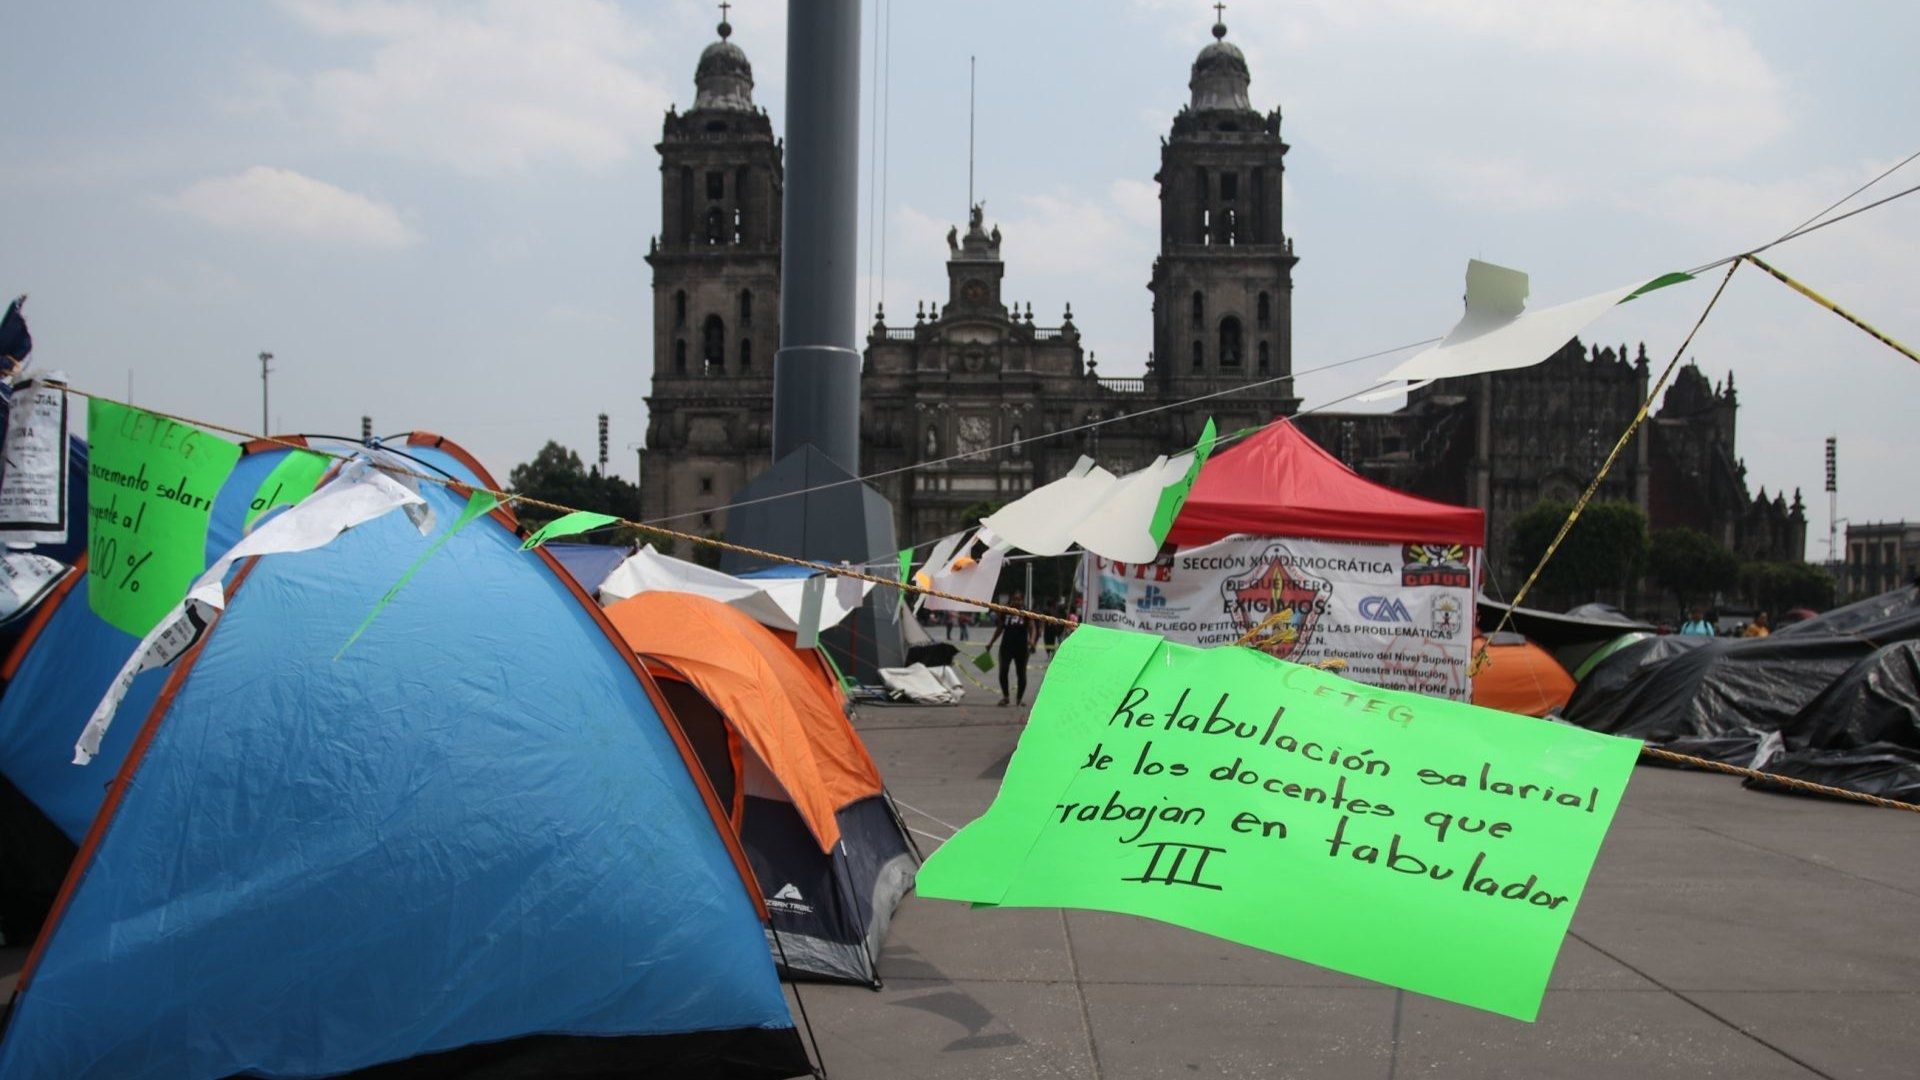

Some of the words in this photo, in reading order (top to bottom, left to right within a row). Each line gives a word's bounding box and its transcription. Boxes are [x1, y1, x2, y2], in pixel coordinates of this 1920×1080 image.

[122, 502, 147, 534] al
[119, 551, 153, 593] %
[1183, 554, 1245, 570] SECCIÓN
[1280, 556, 1394, 576] DEMOCRÁTICA
[1226, 579, 1244, 592] DE
[1248, 578, 1331, 594] GUERRERO
[1224, 599, 1332, 615] EXIGIMOS:
[1138, 620, 1154, 631] AL
[1155, 621, 1198, 632] PLIEGO
[1327, 624, 1352, 635] LAS
[1354, 625, 1454, 641] PROBLEMÁTICAS
[1324, 648, 1374, 660] Educativo
[1376, 651, 1393, 661] del
[1395, 652, 1420, 664] Nivel
[1353, 666, 1391, 676] nuestra
[1282, 667, 1416, 728] CETEG
[1449, 688, 1467, 697] por
[1108, 687, 1391, 777] Retabulación
[1416, 762, 1599, 813] salarial
[1133, 741, 1190, 777] los
[1209, 757, 1396, 817] docentes
[1424, 811, 1512, 843] que
[1120, 842, 1227, 892] III
[1231, 812, 1287, 840] en
[1325, 815, 1569, 910] tabulador
